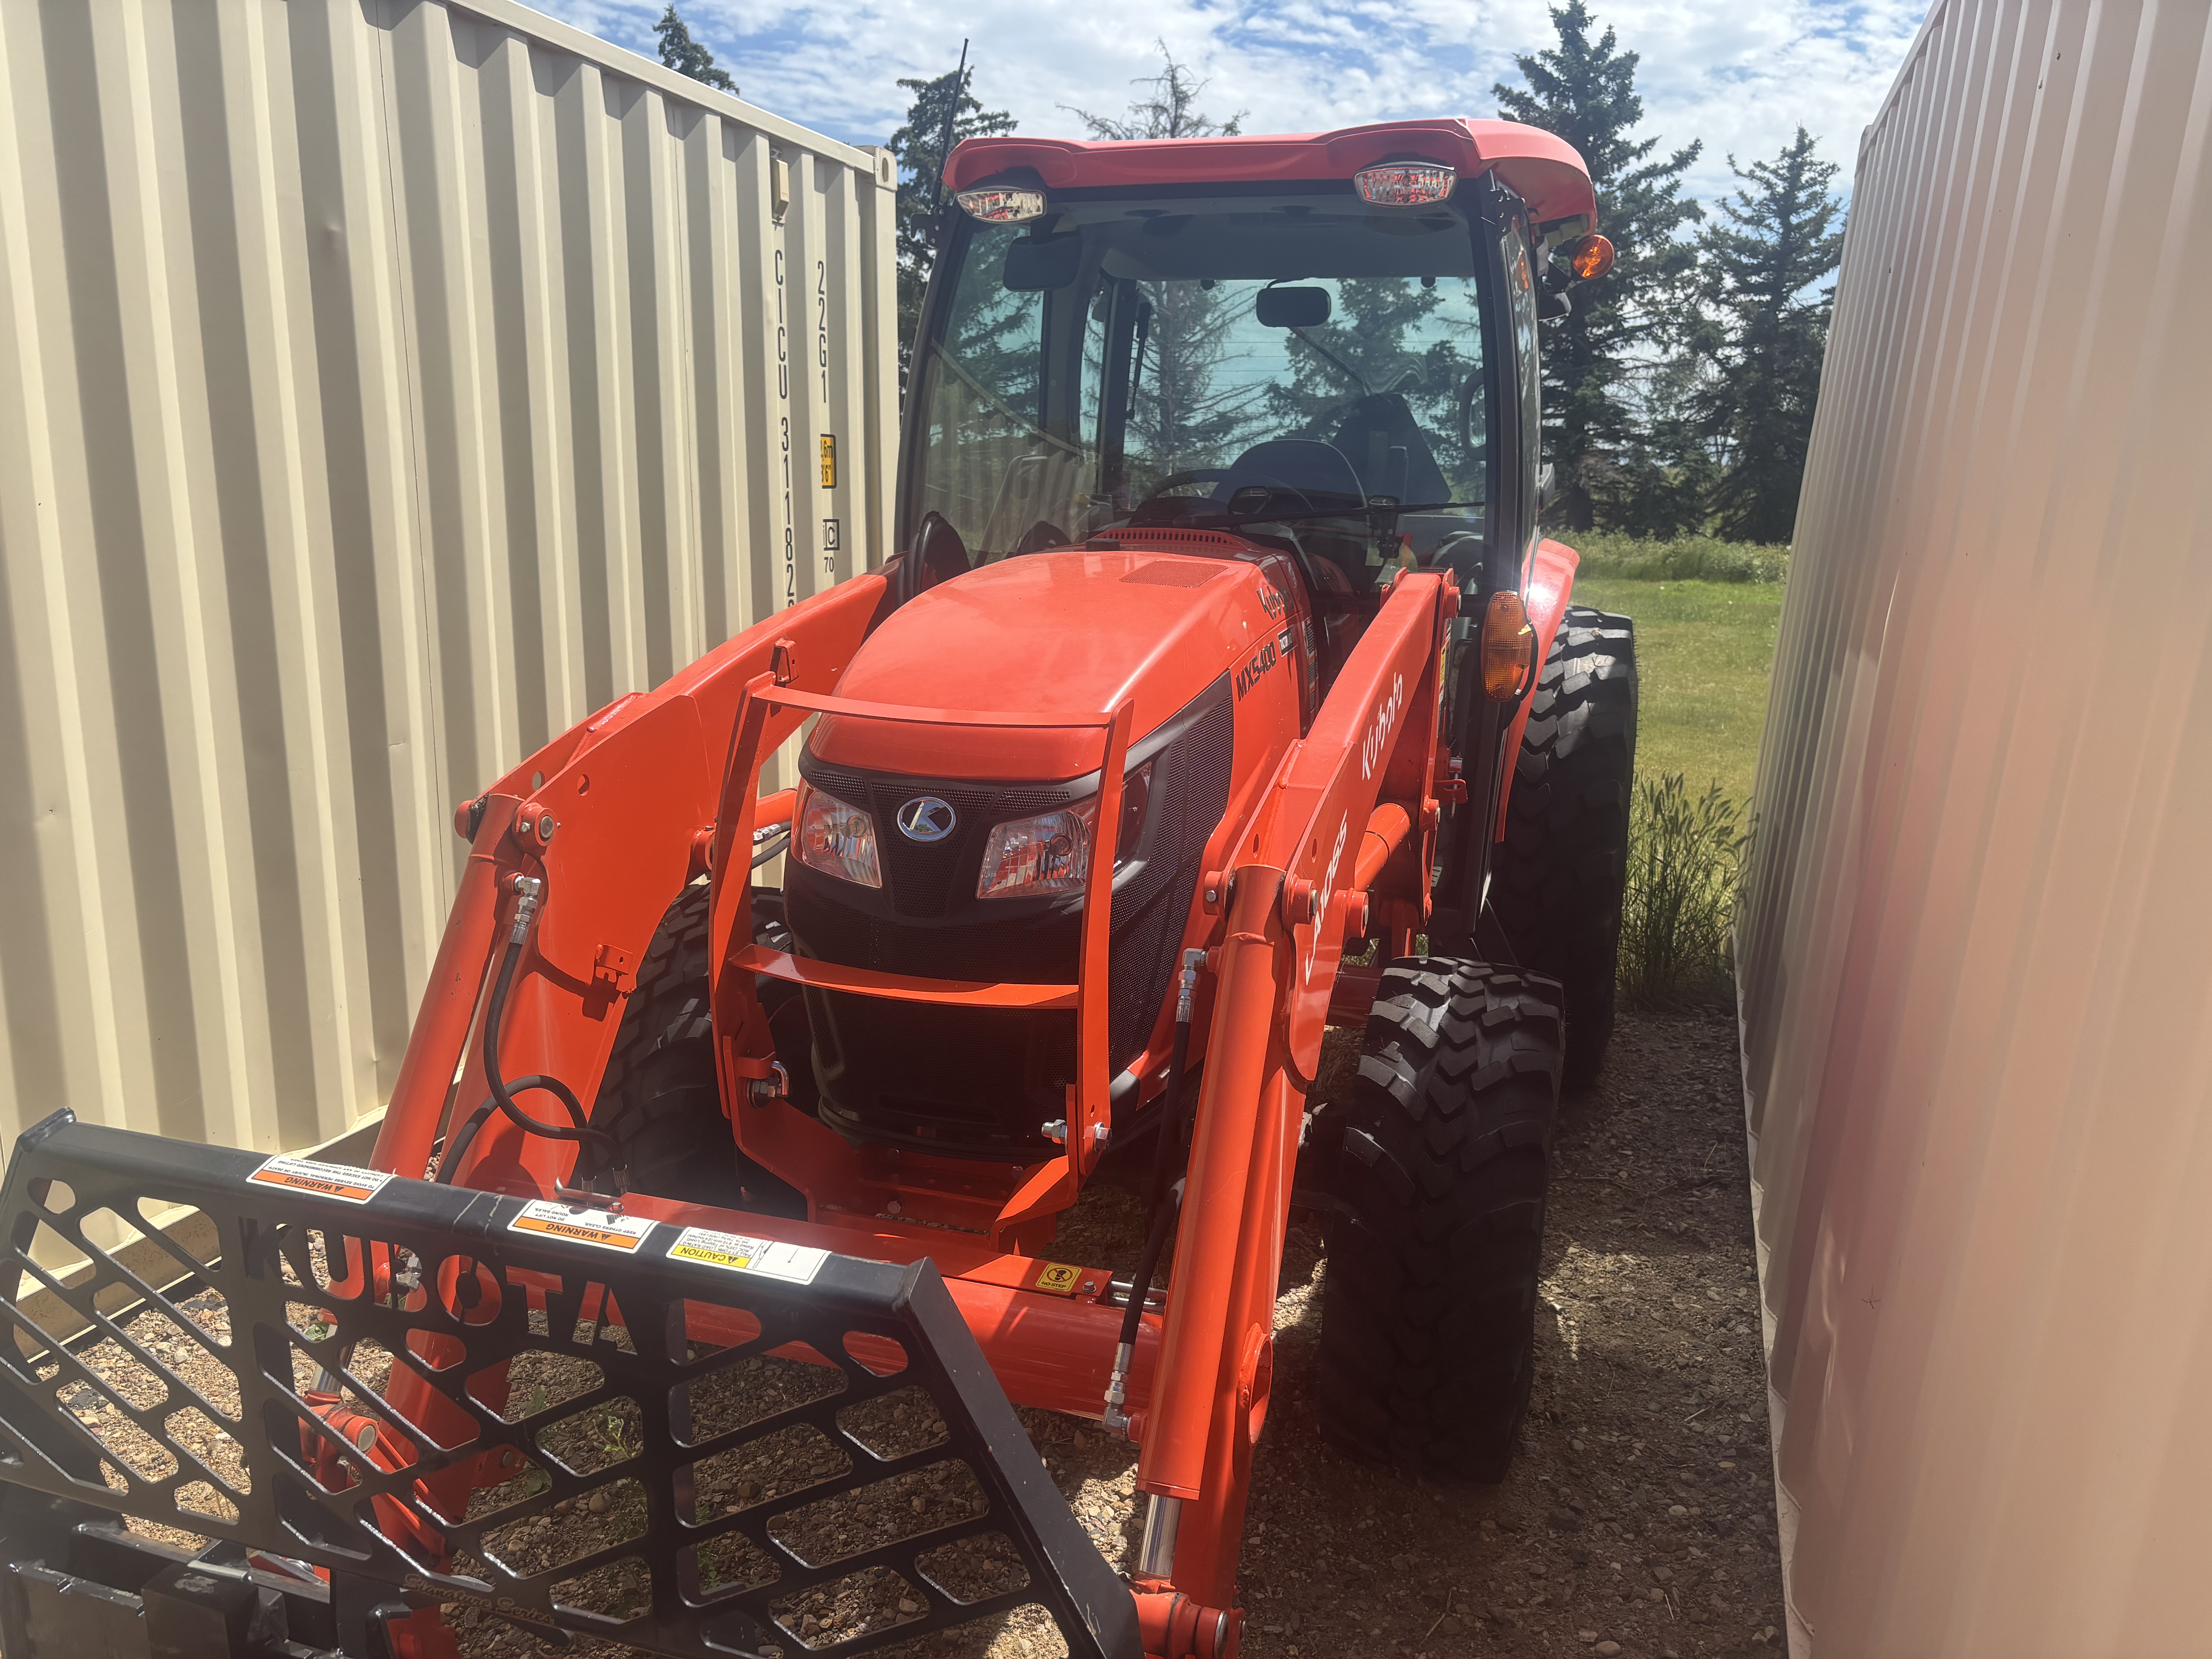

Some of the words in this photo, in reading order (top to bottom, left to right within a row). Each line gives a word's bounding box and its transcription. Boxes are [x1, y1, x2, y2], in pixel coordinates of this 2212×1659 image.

[775, 249, 787, 400] CICU
[817, 260, 827, 403] 22G1
[824, 557, 834, 573] 70
[1235, 641, 1276, 702] MX5400
[1362, 672, 1402, 780] Kubota
[285, 1177, 333, 1191] WARNING
[545, 1224, 599, 1238] WARNING
[680, 1247, 726, 1261] CAUTION
[238, 1216, 637, 1355] KUBOTA
[496, 1597, 555, 1625] Series
